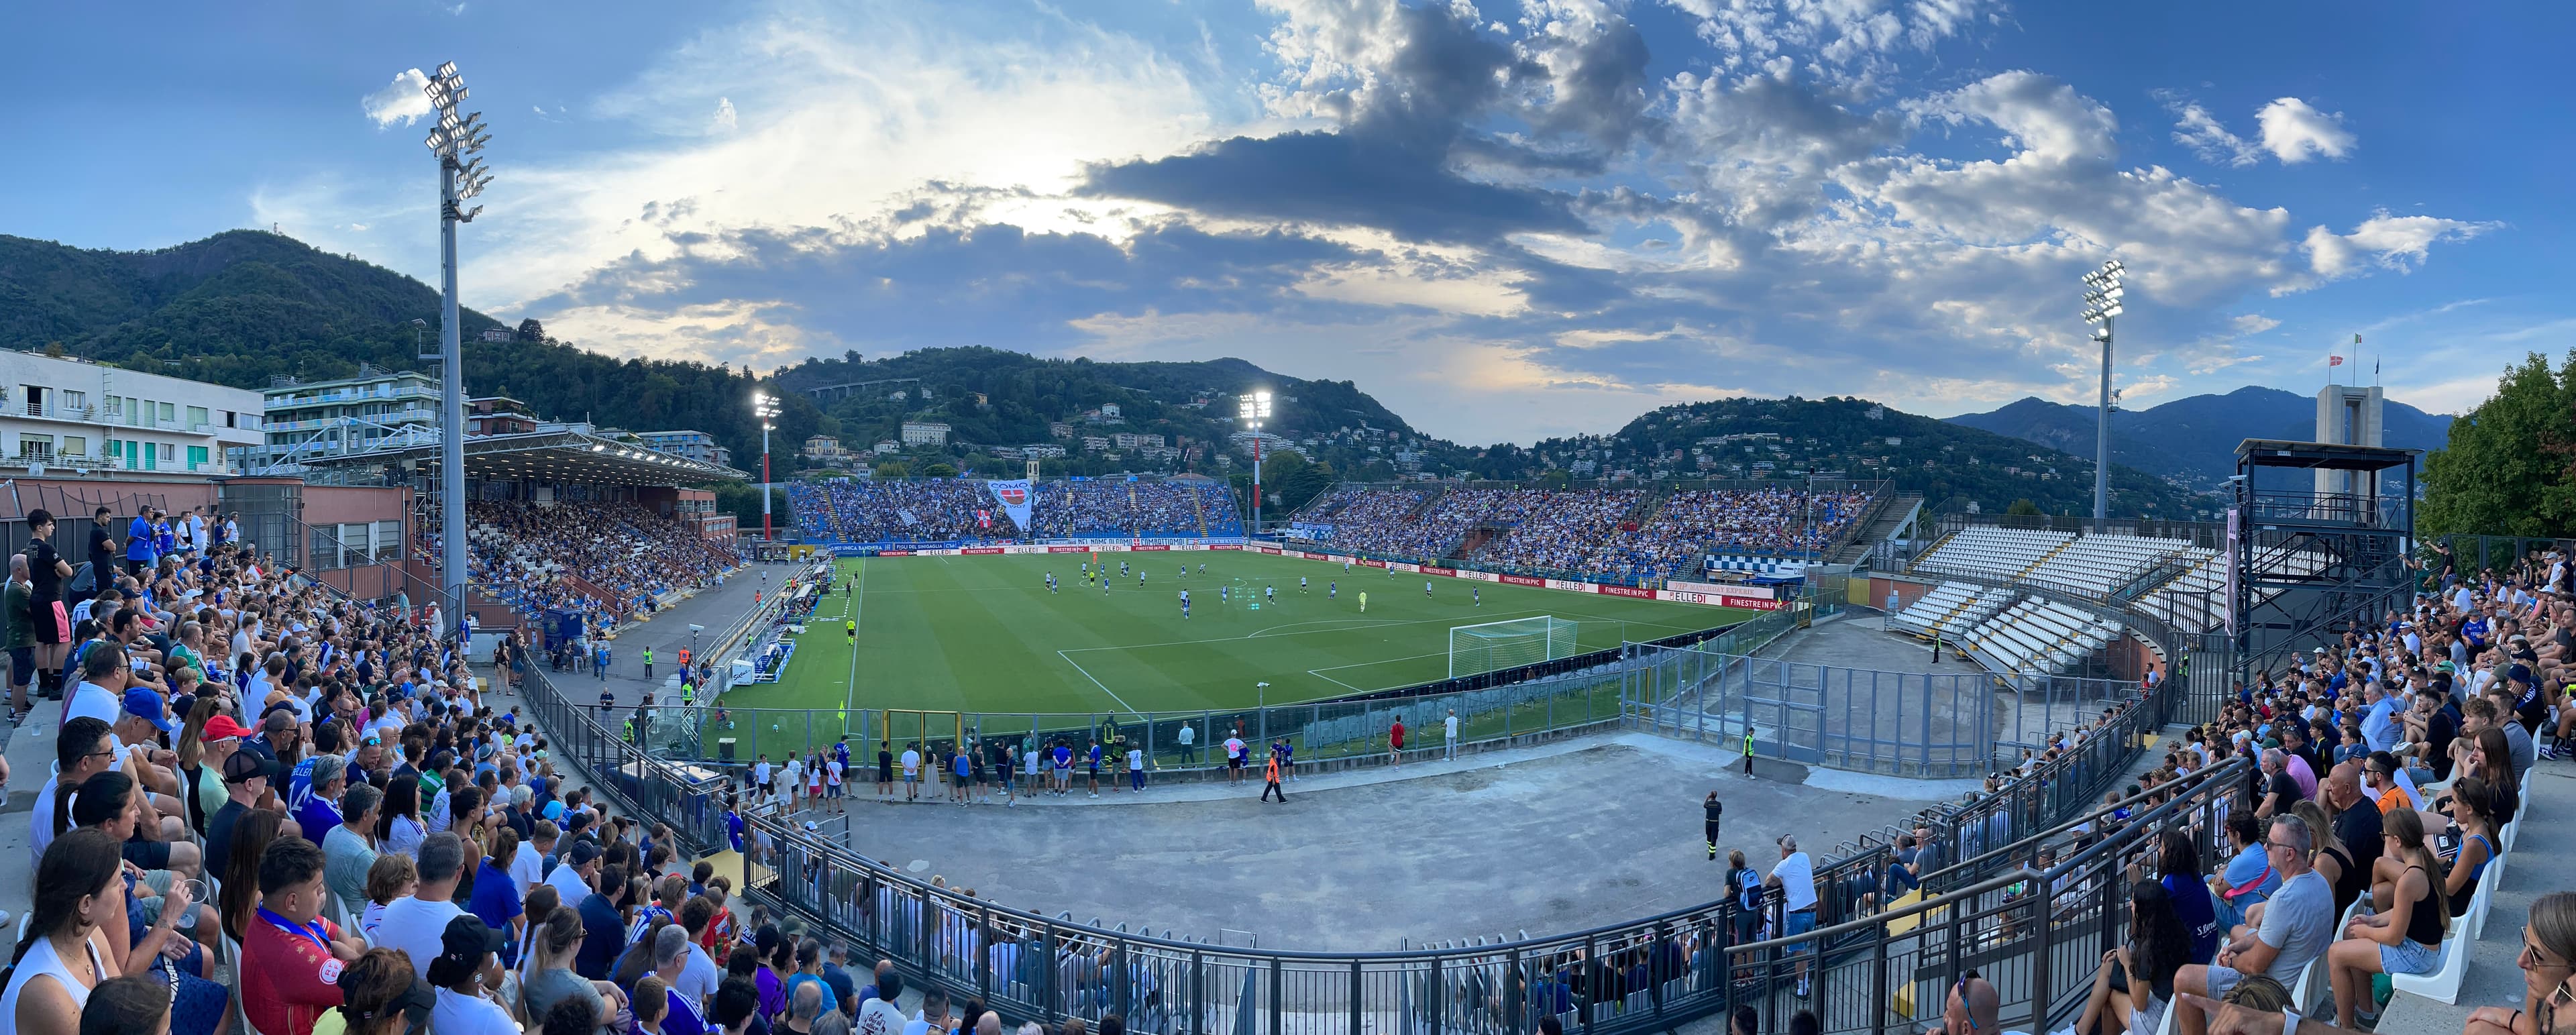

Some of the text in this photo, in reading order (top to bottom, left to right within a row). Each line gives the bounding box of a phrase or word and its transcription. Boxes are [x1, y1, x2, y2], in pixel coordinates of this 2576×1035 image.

[1560, 581, 1585, 592] ELLEDI
[1605, 587, 1631, 596] FINESTRE
[1675, 592, 1706, 603] ELLEDI
[1730, 598, 1761, 608] FINESTRE
[288, 779, 312, 814] 14
